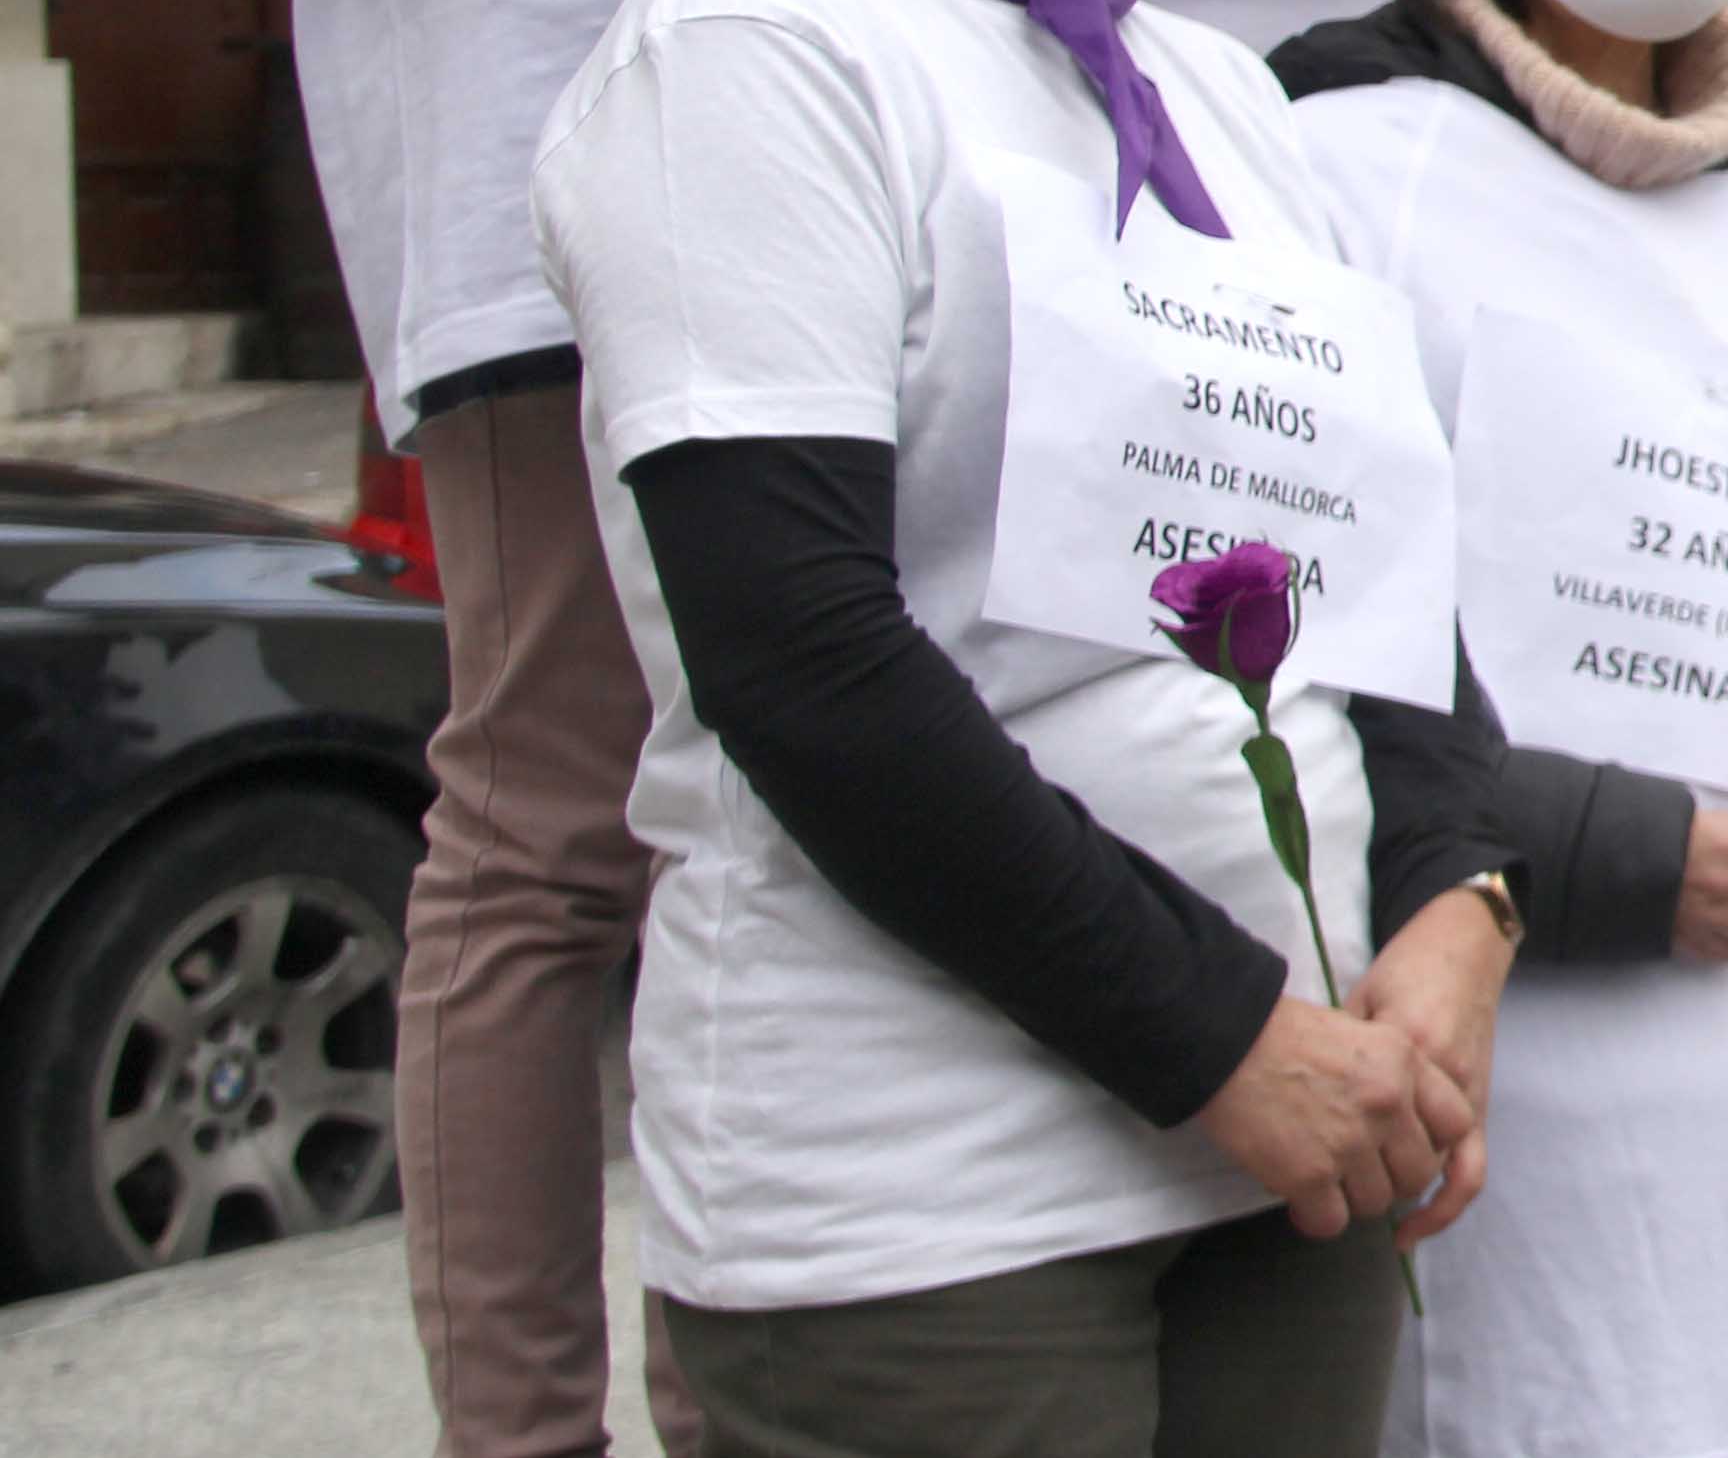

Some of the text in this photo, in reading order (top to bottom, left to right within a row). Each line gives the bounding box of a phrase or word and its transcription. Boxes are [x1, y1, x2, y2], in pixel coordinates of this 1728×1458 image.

[1122, 281, 1344, 375] SACRAMENTO
[1183, 374, 1317, 443] 36 AÑOS
[1122, 441, 1357, 525] PALMA DE MALLORCA
[1133, 517, 1325, 596] ASESIA
[1626, 516, 1672, 555] 32
[1553, 573, 1708, 627] VILLAVERDE
